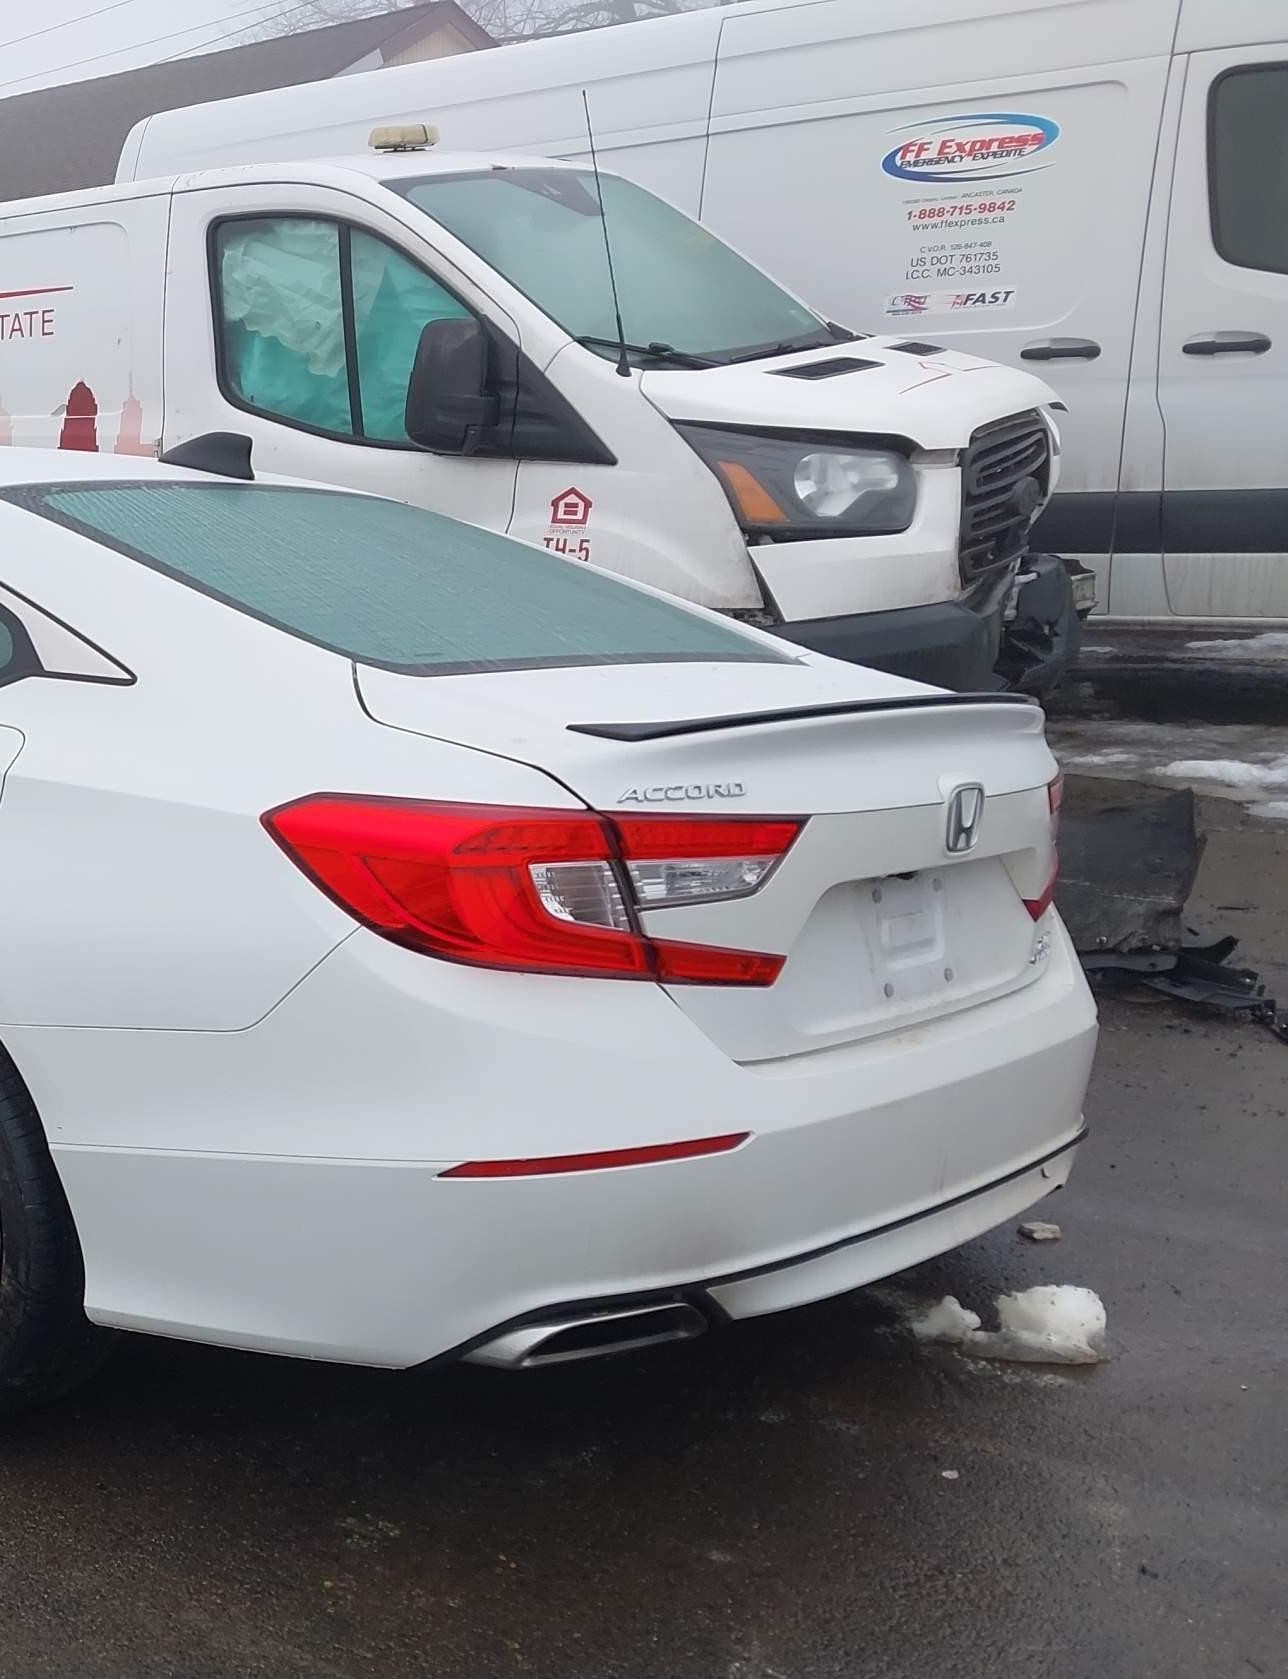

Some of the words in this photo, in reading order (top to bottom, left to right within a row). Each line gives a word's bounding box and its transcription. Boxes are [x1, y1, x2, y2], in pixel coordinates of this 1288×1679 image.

[900, 140, 934, 160] FF
[938, 132, 1046, 157] Express
[899, 155, 965, 169] EMERGENCY
[906, 199, 1016, 220] 1-888-715-9842
[912, 215, 1005, 231] www.ffexpress.ca
[910, 256, 927, 268] US
[930, 254, 956, 266] DOT
[959, 251, 999, 264] 761735
[936, 263, 1001, 278] MC-343105
[963, 290, 1014, 306] FAST
[616, 782, 746, 803] ACCORD
